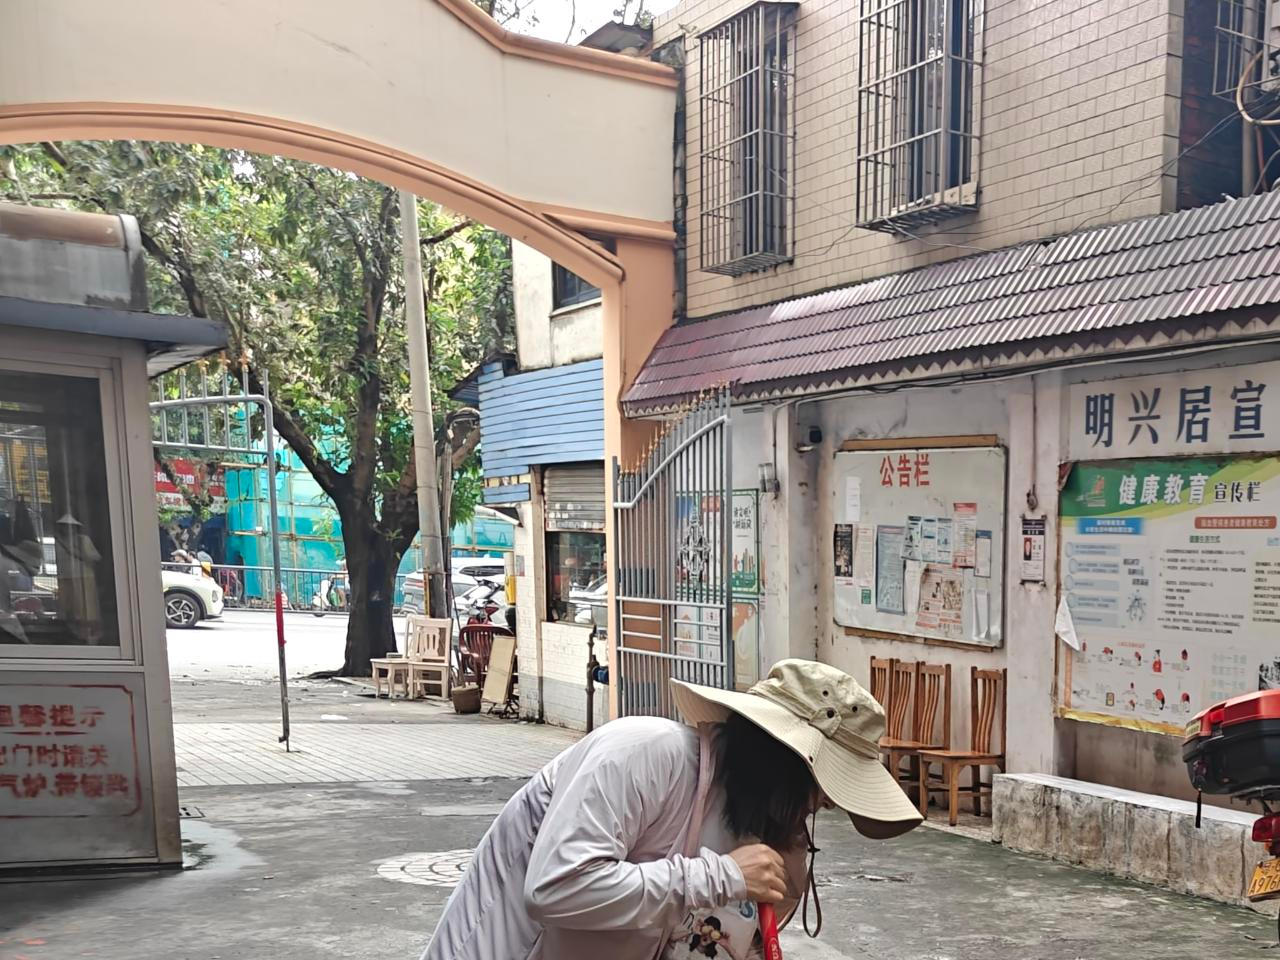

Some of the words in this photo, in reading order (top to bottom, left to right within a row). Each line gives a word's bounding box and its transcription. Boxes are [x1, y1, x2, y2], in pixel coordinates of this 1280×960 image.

[879, 453, 930, 487] 公告栏
[1118, 473, 1210, 505] 健康教育
[1214, 481, 1262, 504] 宣传栏
